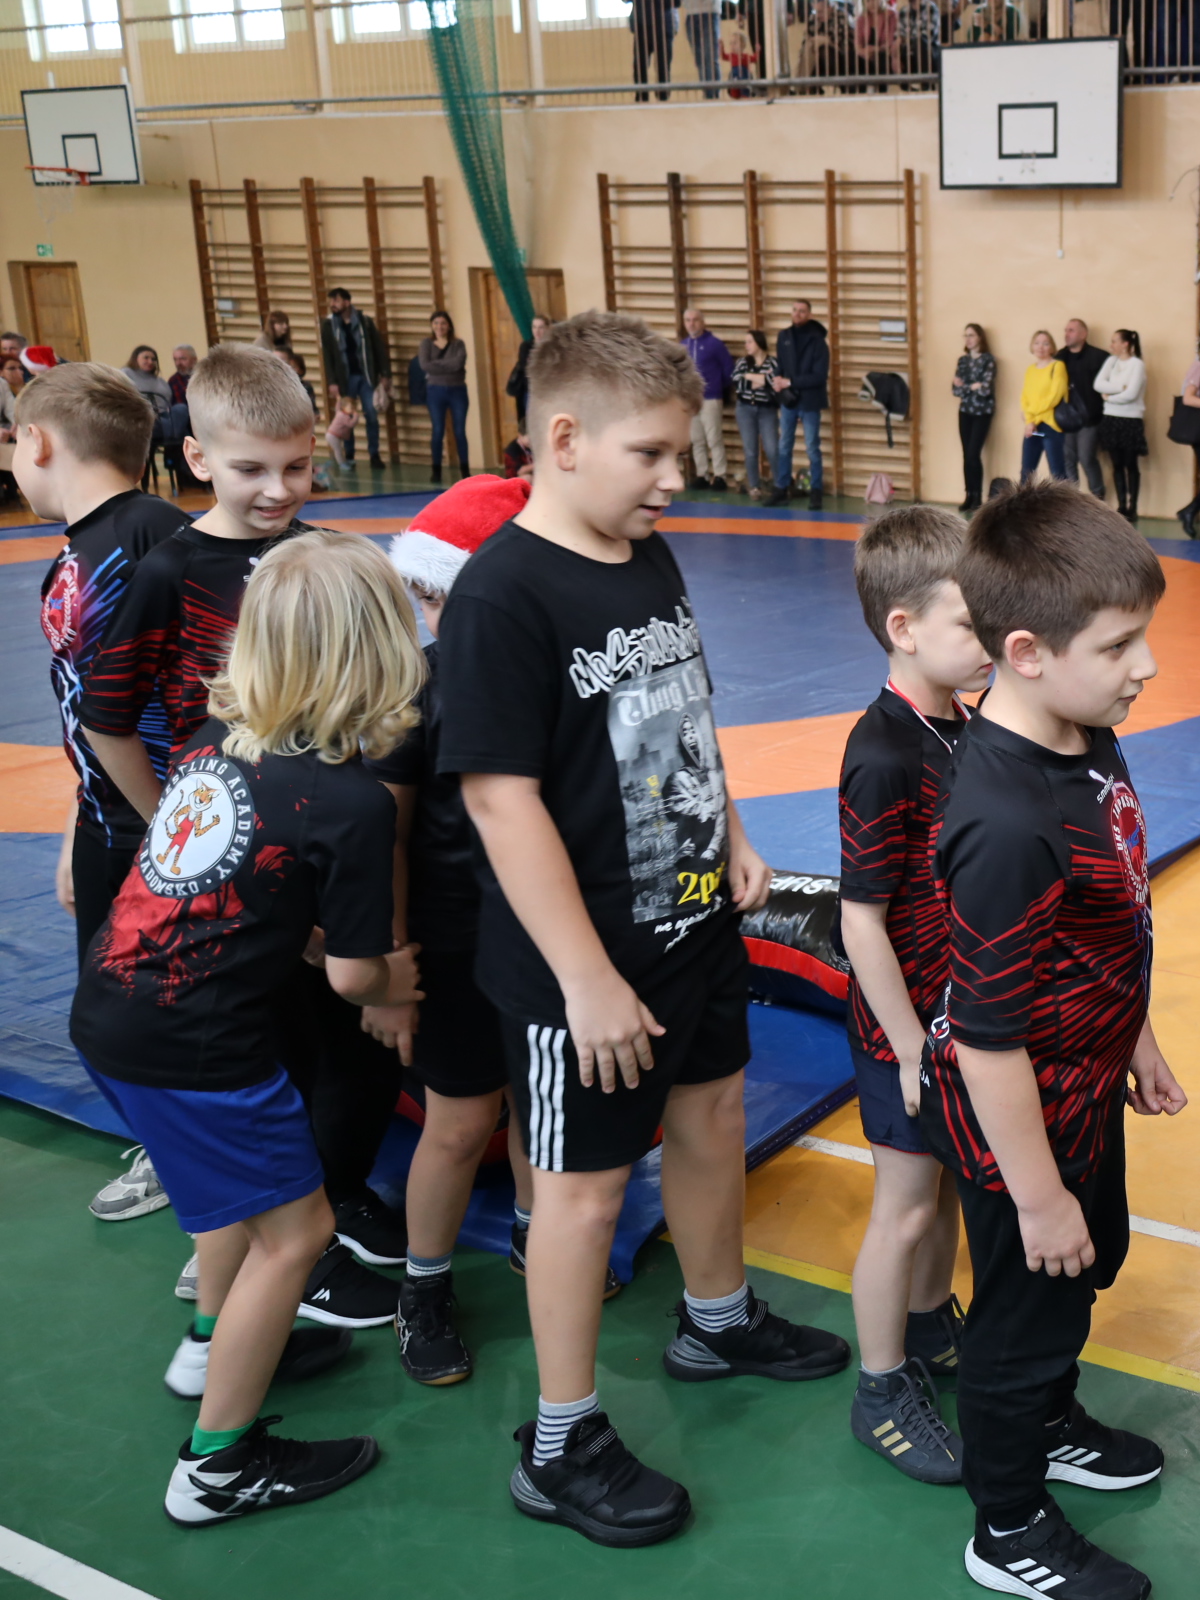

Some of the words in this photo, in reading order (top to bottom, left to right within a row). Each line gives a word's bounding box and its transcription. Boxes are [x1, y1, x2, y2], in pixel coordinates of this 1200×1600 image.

[215, 775, 251, 880] ACADEMY
[1113, 825, 1124, 851] UKS
[139, 850, 200, 897] RADOMSKO
